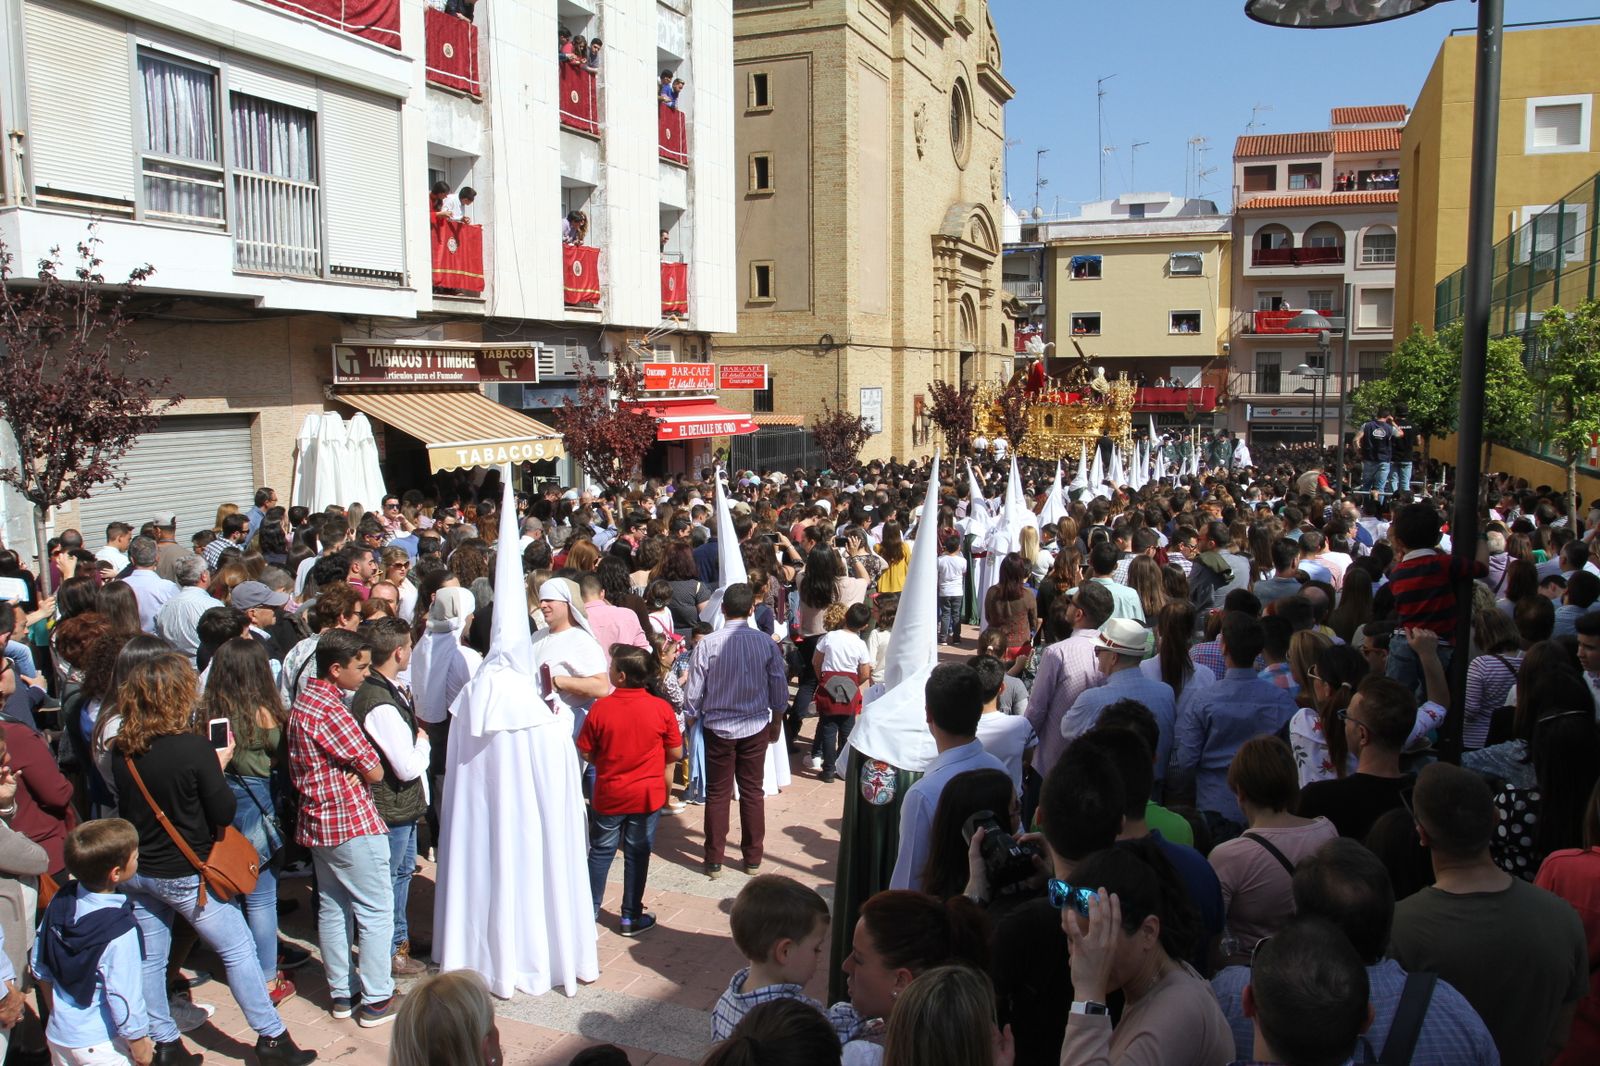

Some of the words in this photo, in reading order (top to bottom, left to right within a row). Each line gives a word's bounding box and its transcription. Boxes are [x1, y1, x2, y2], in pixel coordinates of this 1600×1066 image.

[367, 348, 422, 368] TABACOS
[425, 350, 433, 368] Y
[435, 351, 476, 369] TIMBRE
[481, 349, 533, 359] TABACOS
[384, 371, 413, 380] Artículos
[414, 373, 429, 382] para
[429, 371, 435, 380] el
[436, 371, 463, 380] Fumador
[671, 365, 711, 377] BAR-CAFÉ
[668, 377, 676, 389] El
[679, 425, 688, 437] EL
[688, 423, 715, 435] DETALLE
[715, 423, 723, 433] DE
[724, 422, 736, 433] ORO
[456, 442, 545, 465] TABACOS
